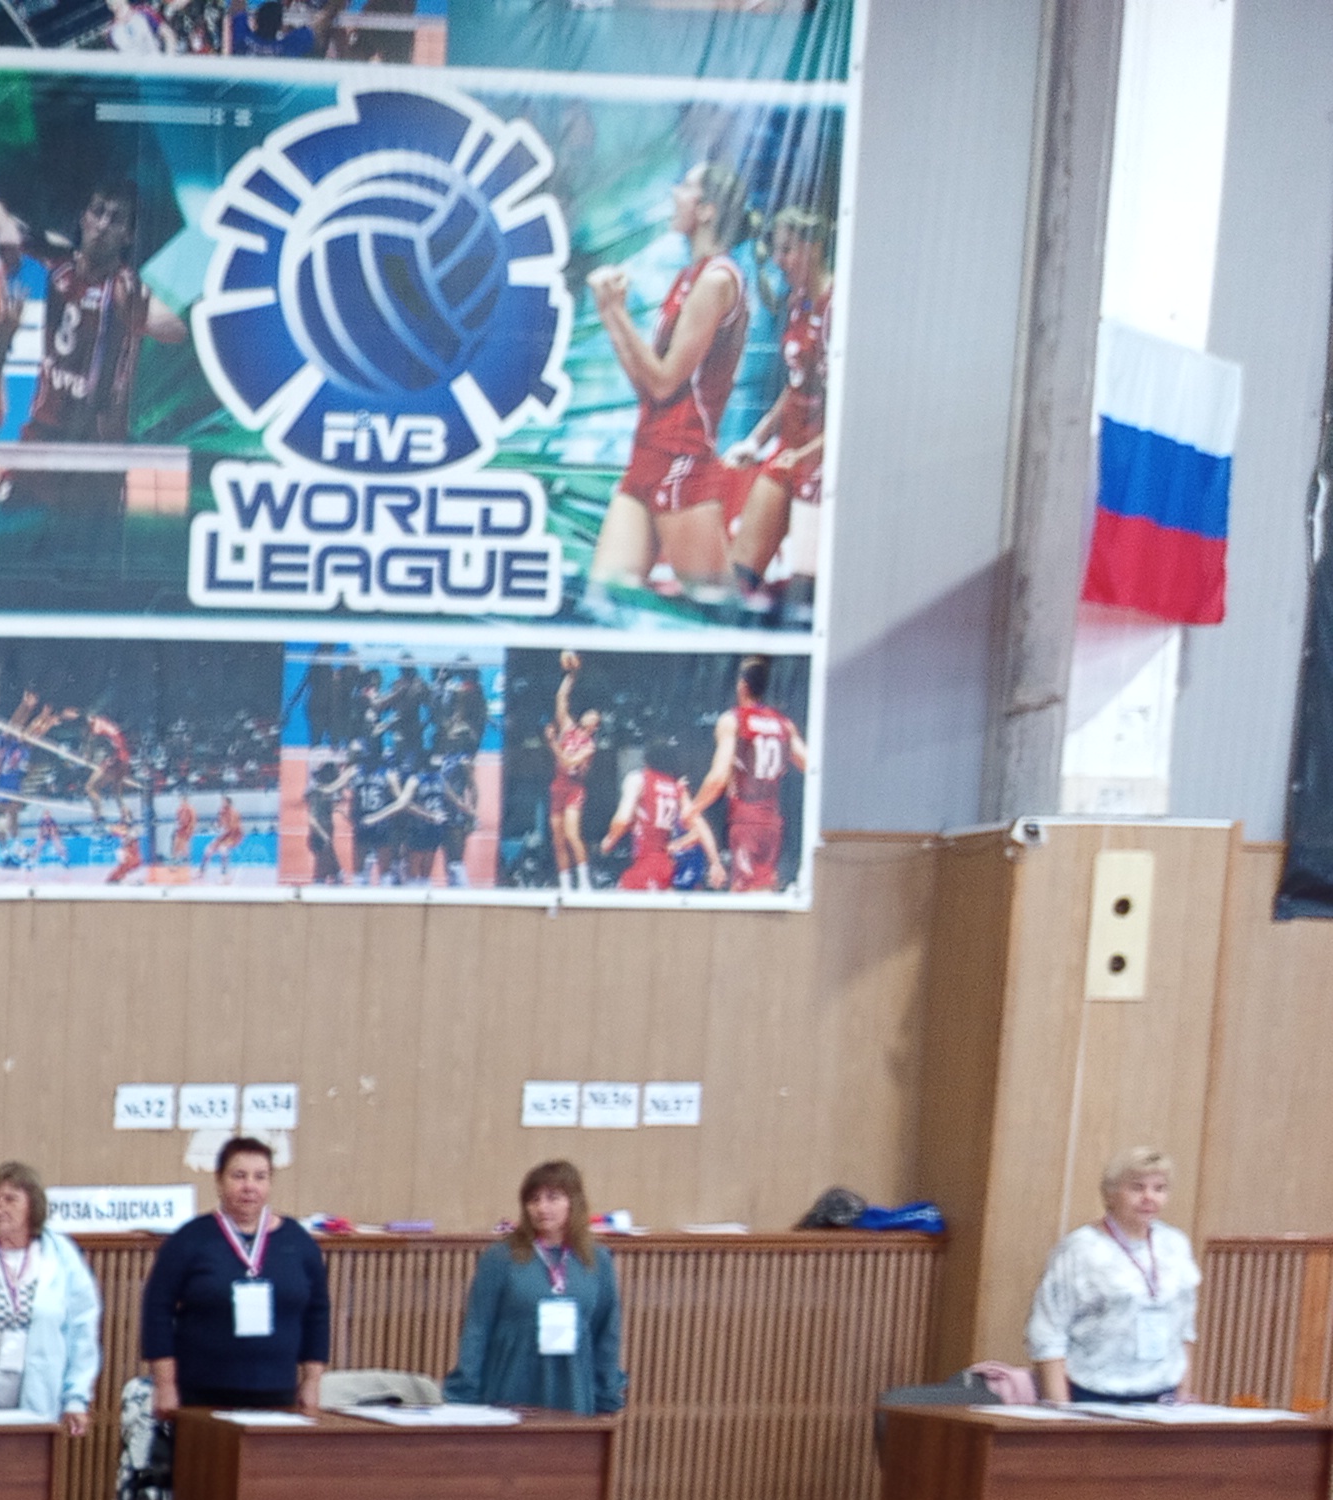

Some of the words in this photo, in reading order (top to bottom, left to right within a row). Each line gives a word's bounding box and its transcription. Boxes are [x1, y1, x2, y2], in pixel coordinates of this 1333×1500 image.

[228, 480, 533, 537] WORLD
[204, 530, 550, 598] LEAGUE
[753, 734, 782, 780] 10
[122, 1099, 165, 1118] №32
